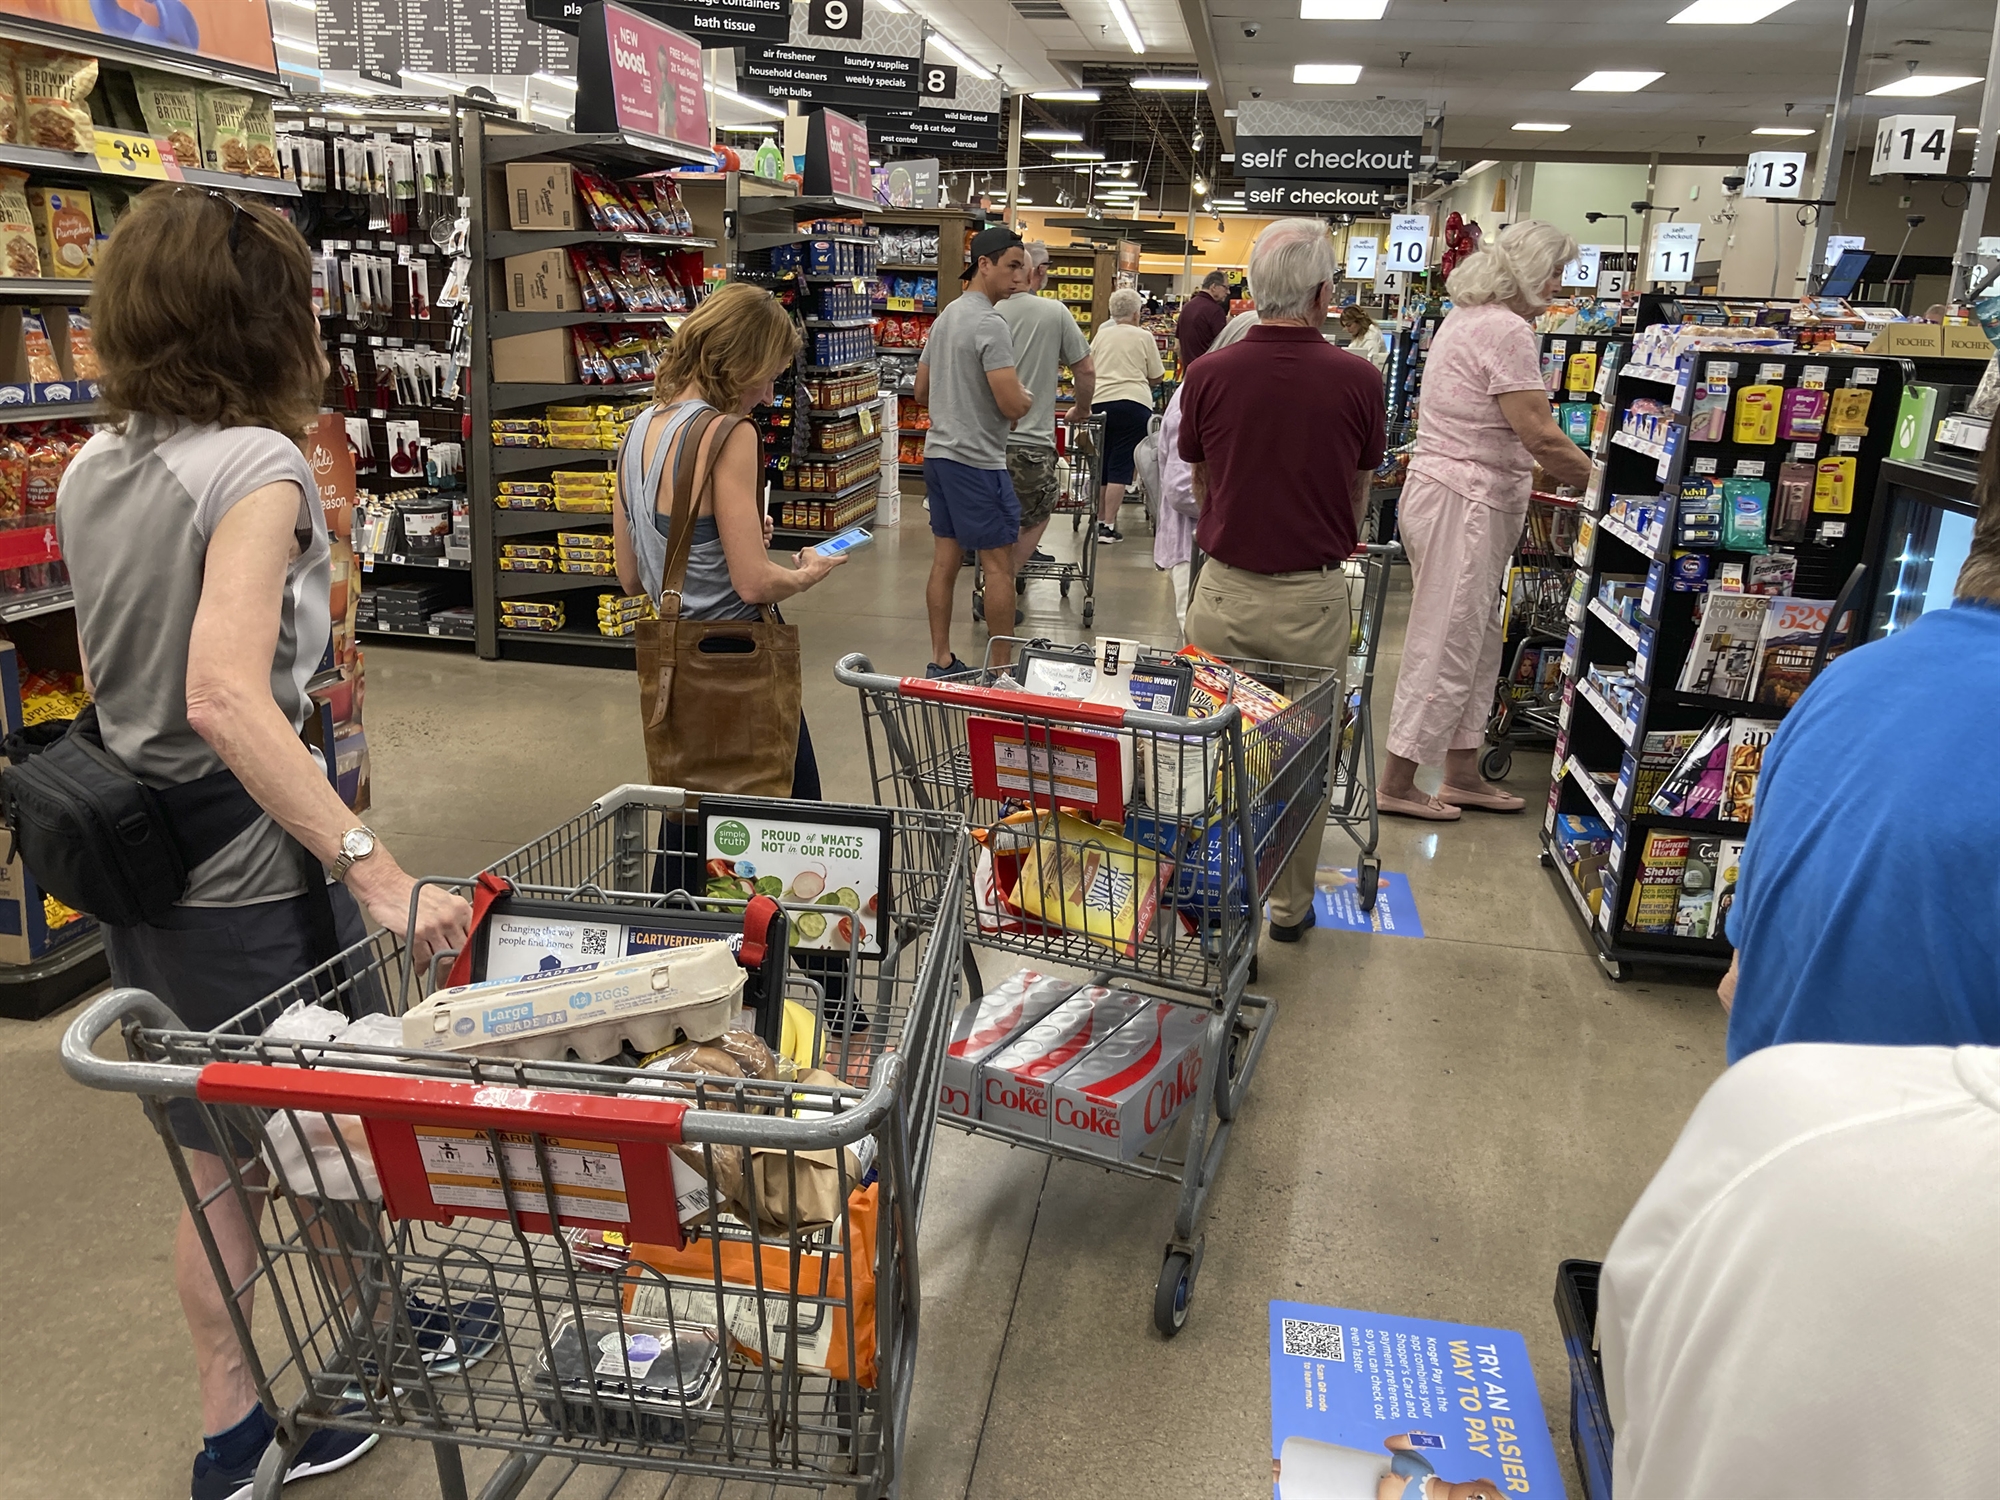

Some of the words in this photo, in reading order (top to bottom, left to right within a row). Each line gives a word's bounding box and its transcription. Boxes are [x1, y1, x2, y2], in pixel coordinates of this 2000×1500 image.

[694, 14, 721, 29] bath
[723, 18, 757, 32] tissue
[825, 0, 849, 30] 9
[619, 26, 639, 48] NEW
[669, 47, 681, 61] FREE
[763, 49, 775, 58] air
[776, 50, 816, 62] freshener
[670, 62, 678, 74] 2X
[677, 65, 687, 77] Fuel
[687, 68, 699, 82] Points
[844, 56, 876, 70] laundry
[877, 59, 910, 71] supplies
[25, 68, 77, 88] BROWNIE
[749, 66, 793, 78] household
[793, 70, 828, 81] cleaners
[845, 75, 874, 87] weekly
[875, 76, 907, 88] specials
[927, 69, 946, 93] 8
[25, 82, 77, 101] BRITTLE
[768, 85, 789, 96] light
[789, 86, 813, 97] bulbs
[153, 92, 189, 108] BROWNIE
[213, 100, 247, 116] BROWNIE
[156, 105, 192, 120] BRITTLE
[215, 113, 240, 127] BRITT
[945, 112, 959, 120] wild
[959, 113, 973, 122] bird
[910, 123, 923, 132] dog
[923, 123, 929, 131] &
[941, 125, 956, 133] food
[880, 135, 895, 144] pest
[895, 136, 918, 144] control
[952, 140, 978, 148] charcoal
[1901, 128, 1946, 161] 14
[1241, 148, 1287, 169] self
[1294, 149, 1413, 170] checkout
[1762, 162, 1798, 188] 13
[1249, 188, 1285, 203] self
[1290, 188, 1379, 206] checkout
[55, 225, 92, 240] Pumpkin
[1395, 224, 1425, 232] checkout
[1663, 232, 1693, 240] checkout
[1393, 242, 1423, 263] 10
[1357, 257, 1368, 272] 7
[1661, 251, 1690, 273] 11
[1578, 264, 1589, 280] 8
[1384, 274, 1395, 288] 4
[1609, 277, 1621, 292] 5
[1896, 337, 1935, 348] ROCHER
[1951, 340, 1990, 351] ROCHER
[324, 484, 337, 498] up
[1681, 487, 1708, 496] Advil
[320, 496, 347, 510] eason
[1753, 562, 1795, 576] Energizer
[1723, 577, 1740, 585] 9.79
[1711, 598, 1742, 609] Home
[1708, 608, 1760, 621] COLOR
[1153, 677, 1177, 687] WORK?
[24, 701, 58, 723] APPLE
[718, 837, 747, 847] truth
[719, 829, 746, 839] simple
[761, 829, 801, 842] PROUD
[806, 833, 816, 844] of
[821, 834, 864, 847] WHAT'S
[761, 841, 785, 854] NOT
[788, 845, 797, 853] in
[800, 845, 825, 857] OUR
[829, 846, 863, 860] FOOD.
[1651, 847, 1680, 857] World
[1644, 867, 1665, 876] She
[1665, 867, 1684, 876] lost
[500, 923, 541, 937] Changing
[542, 927, 557, 936] the
[558, 930, 575, 939] way
[636, 931, 717, 947] CARTVERTISING
[498, 937, 528, 948] people
[528, 938, 544, 948] find
[545, 938, 574, 950] homes
[476, 975, 518, 988] Large
[525, 967, 570, 982] GRADE
[576, 963, 593, 973] AA
[601, 955, 639, 967] EGGS
[575, 994, 587, 1007] 12
[593, 985, 630, 1003] EGGS
[487, 1004, 530, 1023] Large
[494, 1015, 541, 1035] GRADE
[546, 1012, 563, 1026] AA
[985, 1078, 1048, 1118] Coke
[1026, 1085, 1045, 1098] Diet
[1143, 1056, 1202, 1135] Coke
[1055, 1097, 1120, 1138] Coke
[1097, 1106, 1117, 1119] Diet
[1350, 1326, 1361, 1347] even
[1365, 1328, 1374, 1340] so
[1365, 1340, 1376, 1357] you
[1379, 1330, 1395, 1368] payment
[1410, 1334, 1422, 1352] app
[1396, 1332, 1410, 1376] Shopper's
[1426, 1336, 1440, 1368] Kroger
[1303, 1361, 1312, 1370] to
[1353, 1348, 1364, 1374] faster.
[1368, 1357, 1379, 1374] can
[1448, 1340, 1476, 1382] WAY
[1475, 1343, 1503, 1379] TRY
[1304, 1370, 1313, 1388] learn
[1316, 1363, 1326, 1381] Scan
[1414, 1353, 1429, 1395] combines
[1431, 1367, 1443, 1385] Pay
[1317, 1381, 1327, 1394] QR
[1371, 1374, 1385, 1402] check
[1384, 1368, 1401, 1420] preference,
[1402, 1377, 1416, 1400] Card
[1436, 1385, 1446, 1396] in
[1483, 1381, 1511, 1411] AN
[1305, 1389, 1313, 1410] more.
[1319, 1393, 1329, 1412] code
[1419, 1395, 1433, 1419] your
[1438, 1396, 1448, 1413] the
[1457, 1385, 1482, 1412] TO
[1374, 1403, 1386, 1420] out
[1406, 1400, 1419, 1419] and
[1463, 1416, 1493, 1459] PAY
[1491, 1415, 1530, 1493] EASIER
